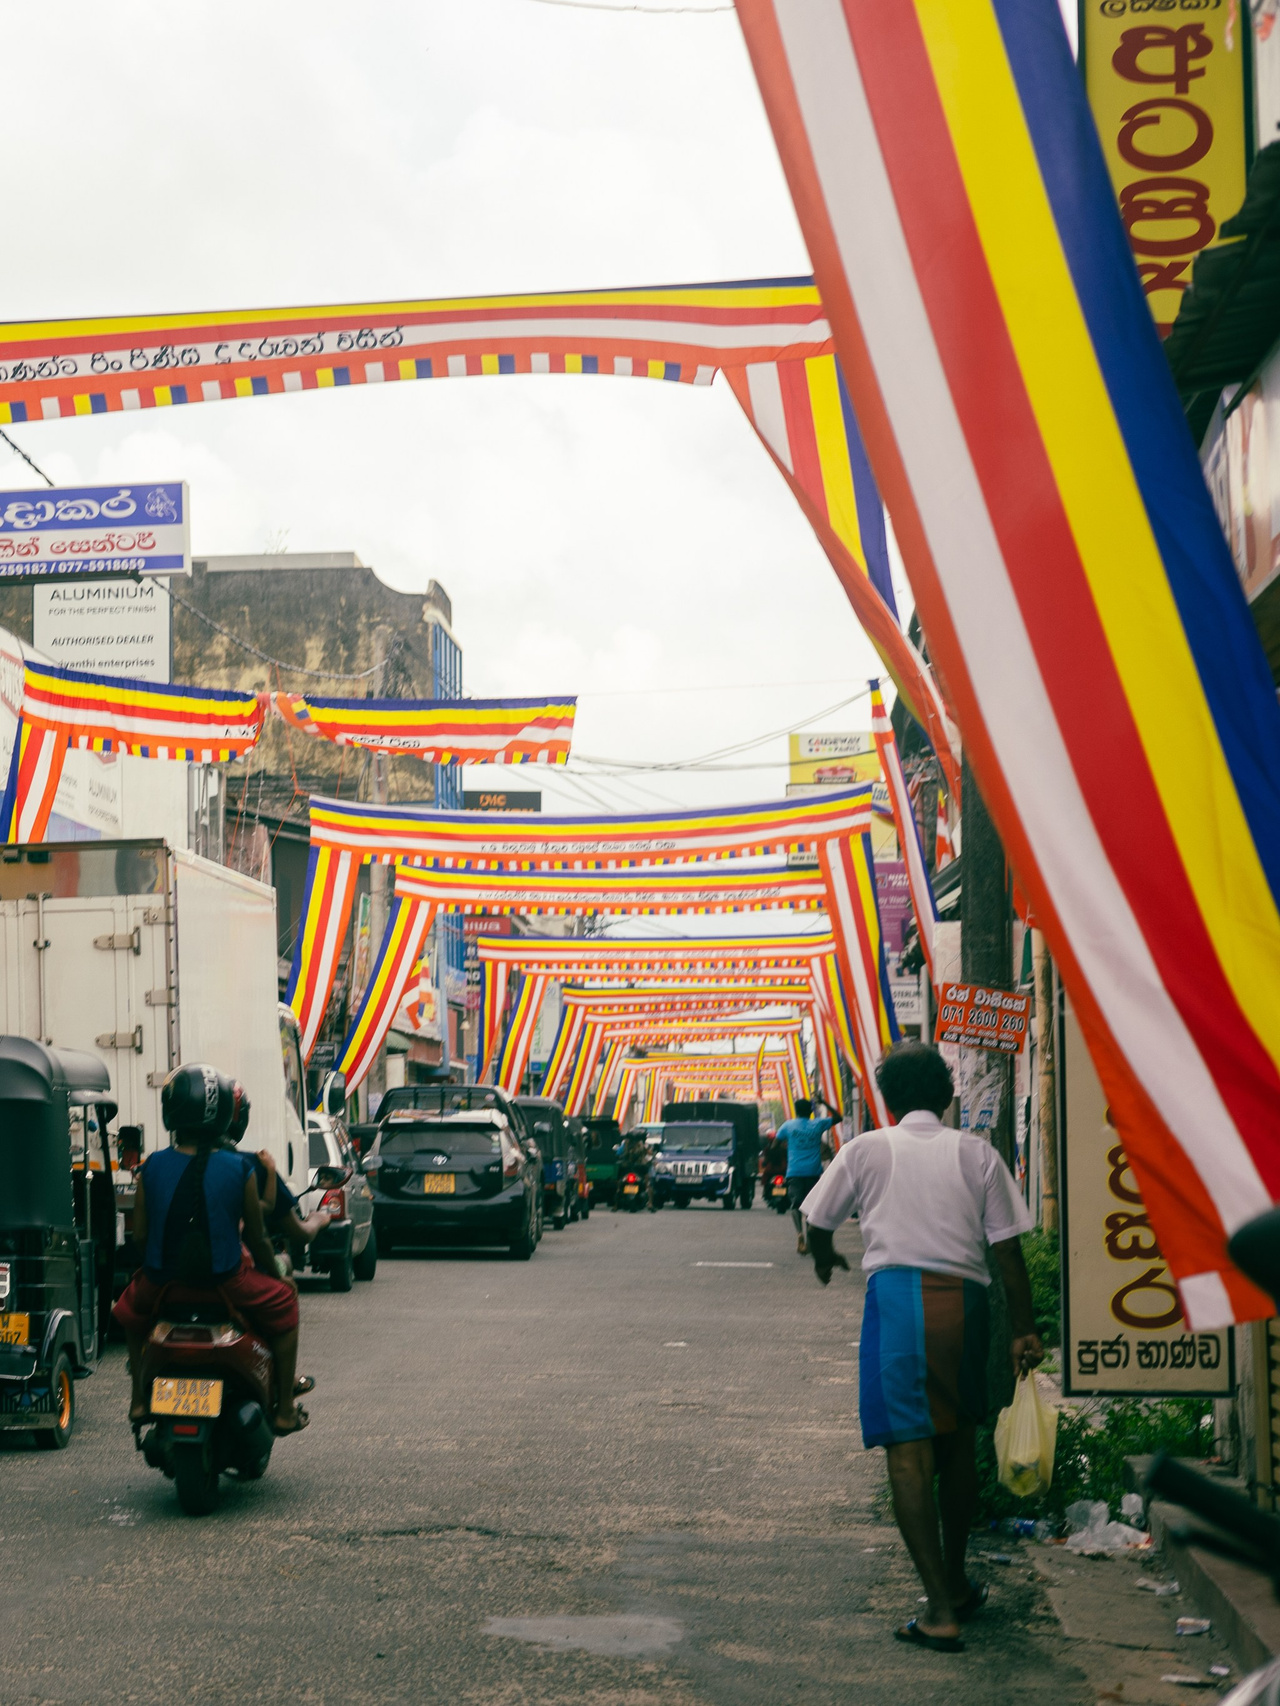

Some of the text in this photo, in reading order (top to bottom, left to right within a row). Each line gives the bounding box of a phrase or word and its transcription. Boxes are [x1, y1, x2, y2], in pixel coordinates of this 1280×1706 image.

[50, 586, 154, 601] ALUMINIUM
[48, 604, 156, 616] FOR THE PERFECT FINISH
[51, 634, 154, 647] AUTHORISED DEALER
[97, 657, 156, 670] enterprises
[941, 1004, 964, 1024] 071
